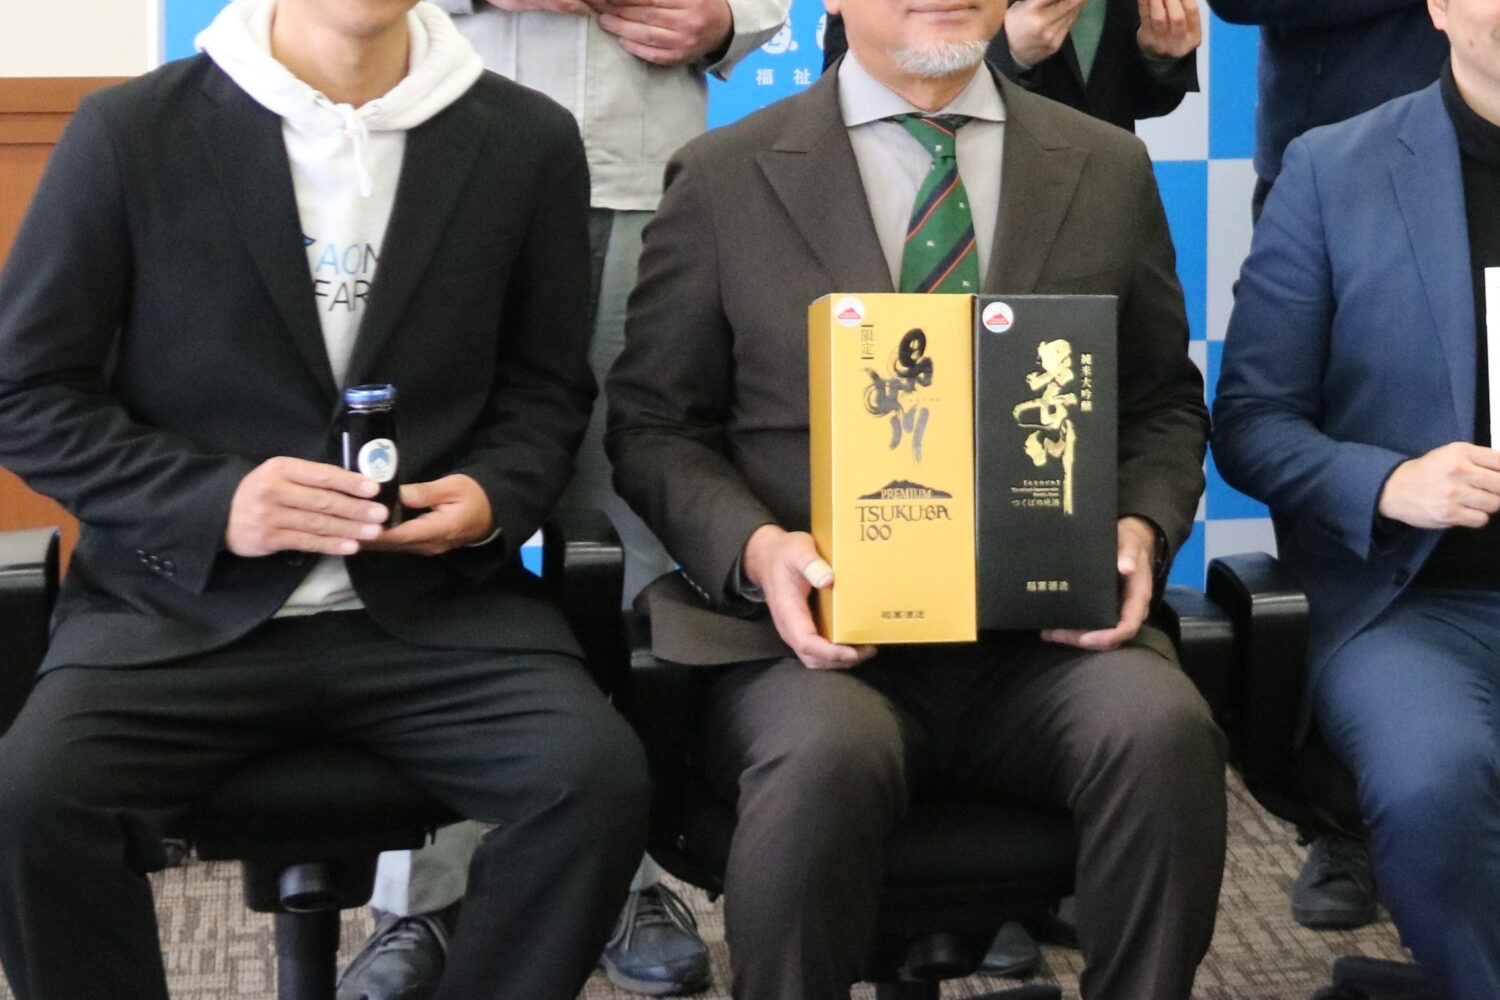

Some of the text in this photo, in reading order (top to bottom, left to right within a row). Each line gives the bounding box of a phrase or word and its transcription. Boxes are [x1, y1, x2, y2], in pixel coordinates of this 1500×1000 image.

[881, 487, 932, 499] PREMIUM
[855, 505, 952, 522] TSUKUBA
[860, 524, 892, 542] 100
